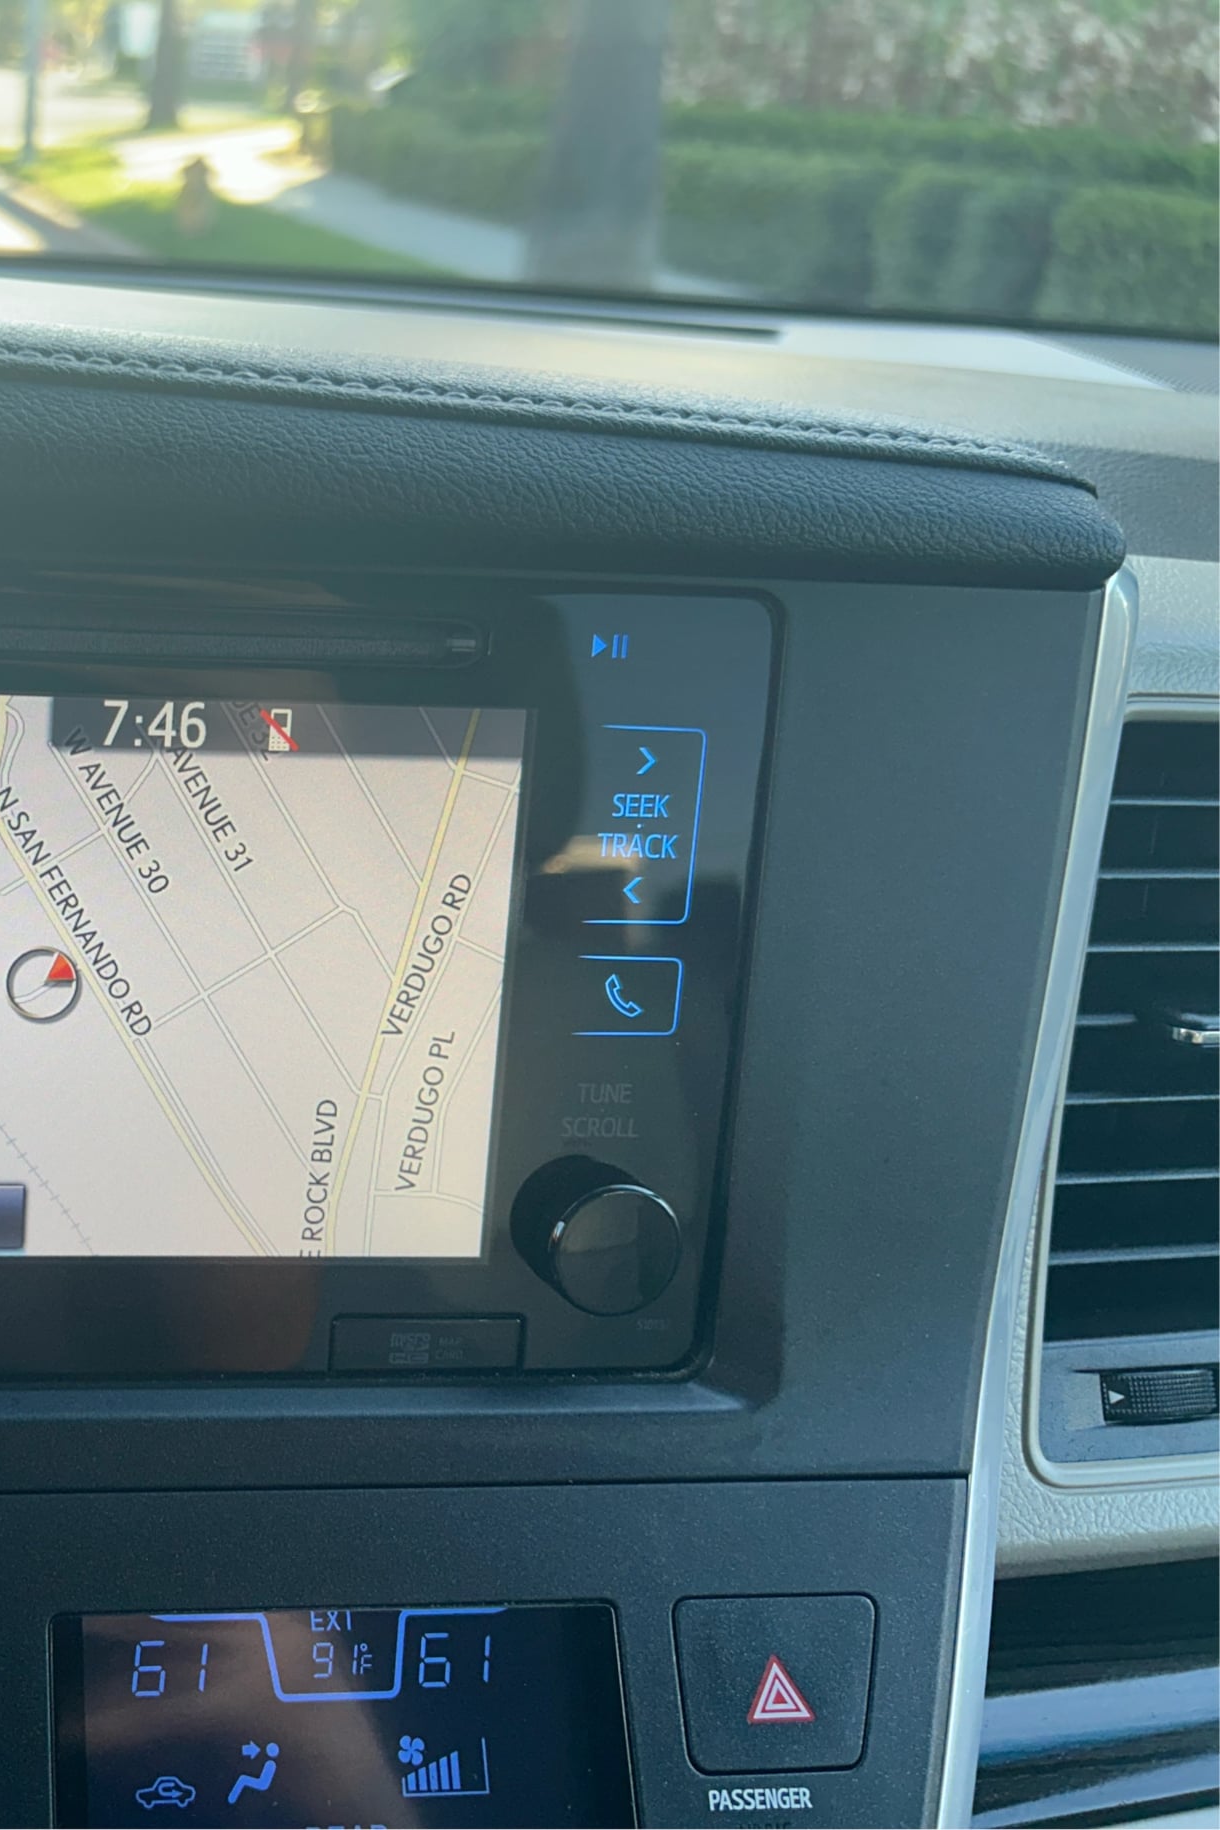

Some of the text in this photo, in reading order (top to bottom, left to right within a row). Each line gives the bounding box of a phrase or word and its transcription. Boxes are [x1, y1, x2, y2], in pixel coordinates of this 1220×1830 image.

[103, 700, 207, 749] 7:46
[78, 762, 151, 861] AVENUE
[138, 859, 170, 894] 30
[165, 746, 254, 872] AVENUE 31
[612, 793, 670, 819] SEEK
[597, 833, 678, 860] TRACK
[7, 811, 52, 866] SAN
[39, 864, 131, 1000] FERNANDO
[120, 1000, 153, 1038] RD
[381, 874, 472, 1037] VERDUGO RD
[395, 1031, 456, 1191] VERDUGO PL
[577, 1082, 633, 1104] TUNE
[310, 1099, 338, 1164] BLVD
[560, 1116, 640, 1138] SCROLL
[301, 1171, 331, 1242] ROCK
[131, 1640, 208, 1697] 61
[418, 1632, 491, 1688] 61
[708, 1787, 813, 1811] PASSENGER
